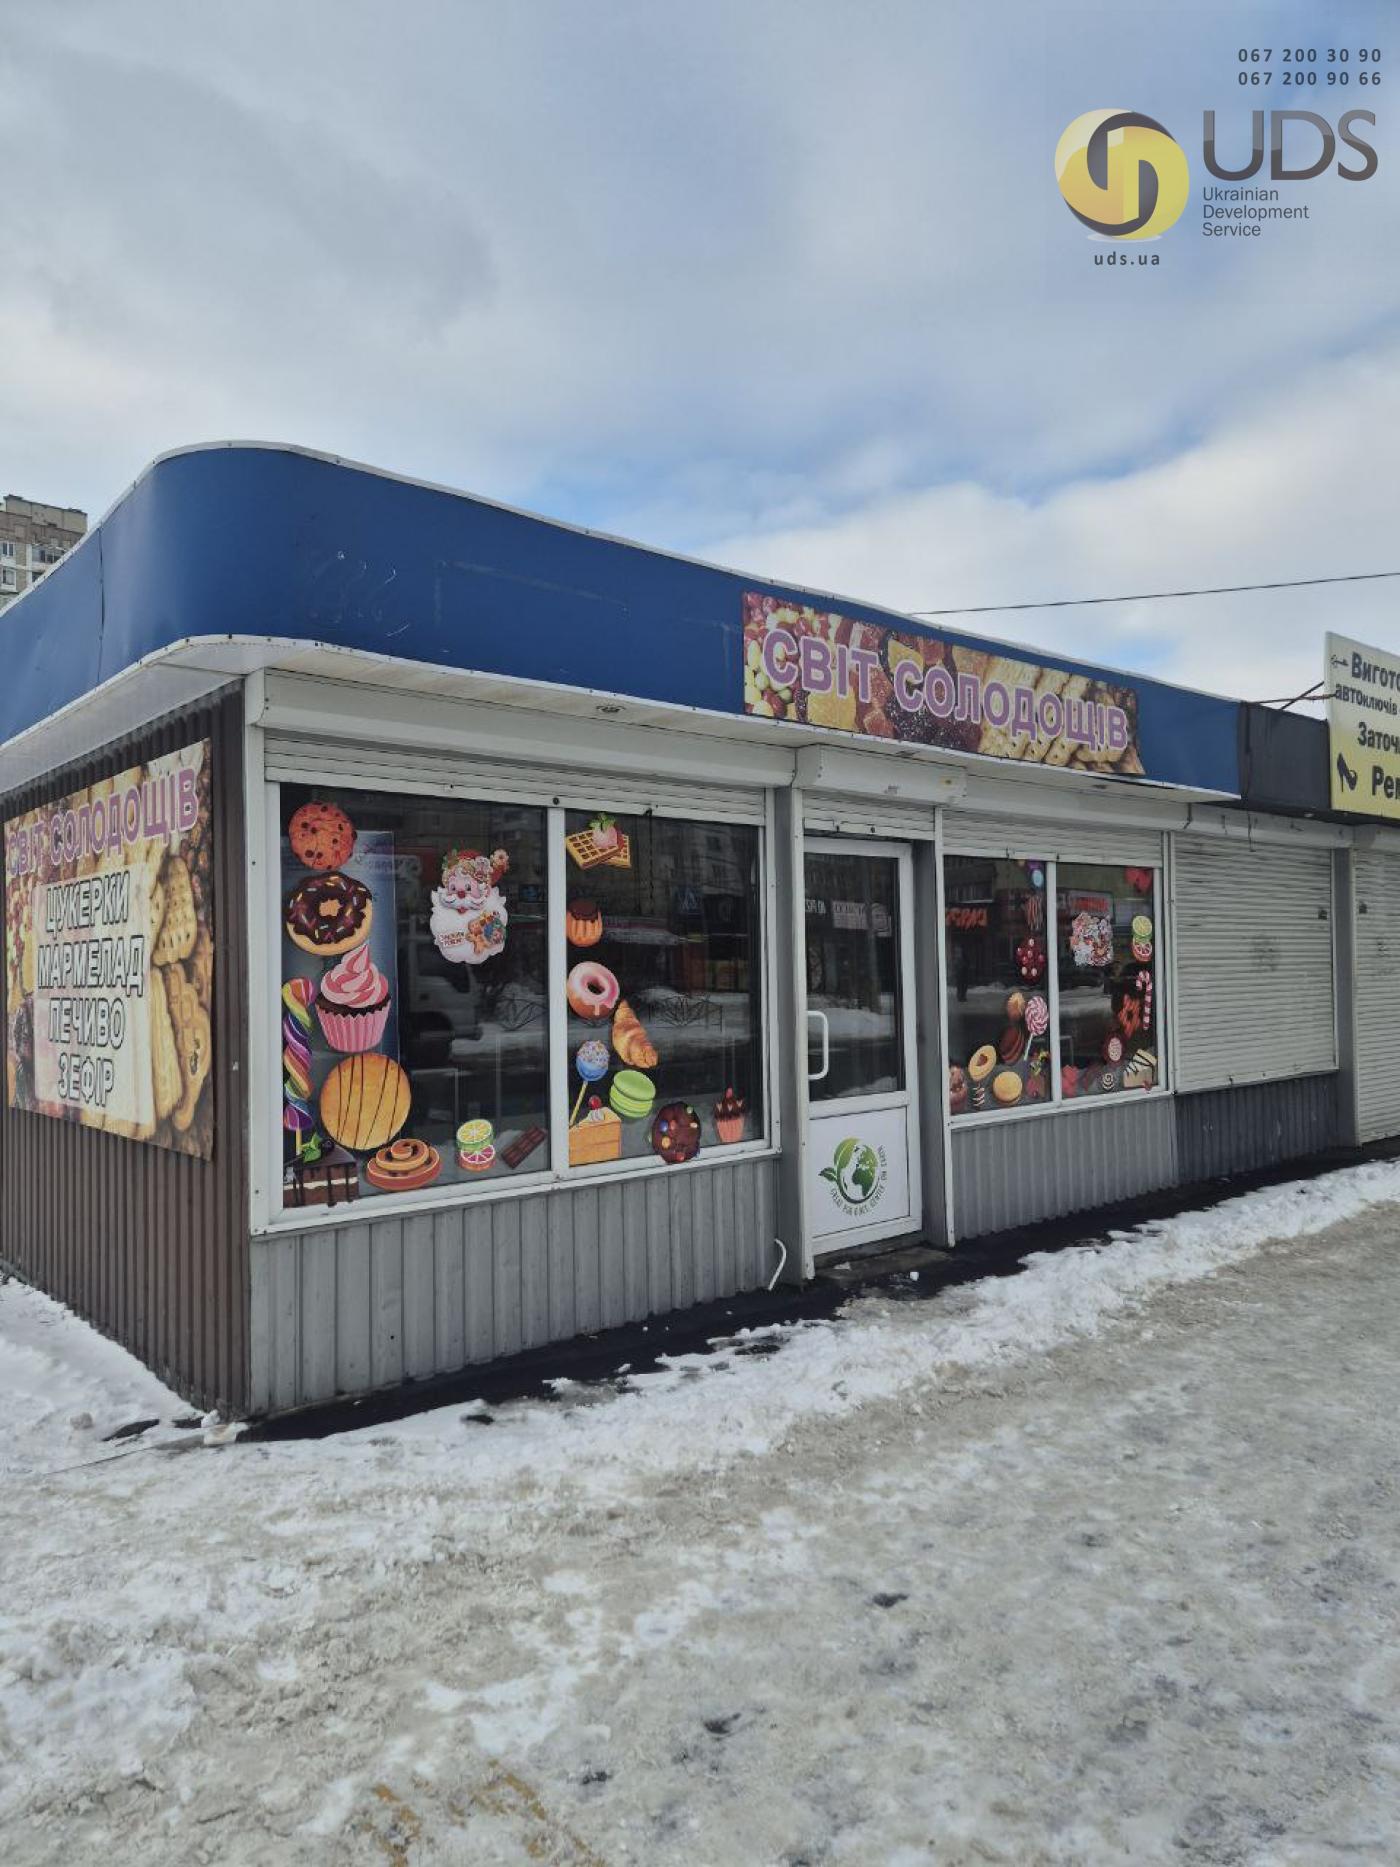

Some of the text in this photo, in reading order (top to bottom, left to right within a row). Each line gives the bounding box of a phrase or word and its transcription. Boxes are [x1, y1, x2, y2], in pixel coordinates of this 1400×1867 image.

[763, 628, 1129, 752] СВІТ СОЛОДОЩІВ
[1335, 683, 1398, 716] автоключів
[1357, 721, 1400, 755] Заточ
[5, 767, 201, 878] СВІТ СОЛОДОЩІВ
[46, 870, 131, 940] ЦУКЕРКИ
[37, 934, 146, 998] МАРМЕЛАД
[48, 996, 127, 1051] ПЕЧИВО
[58, 1051, 116, 1108] ЗЕФІР
